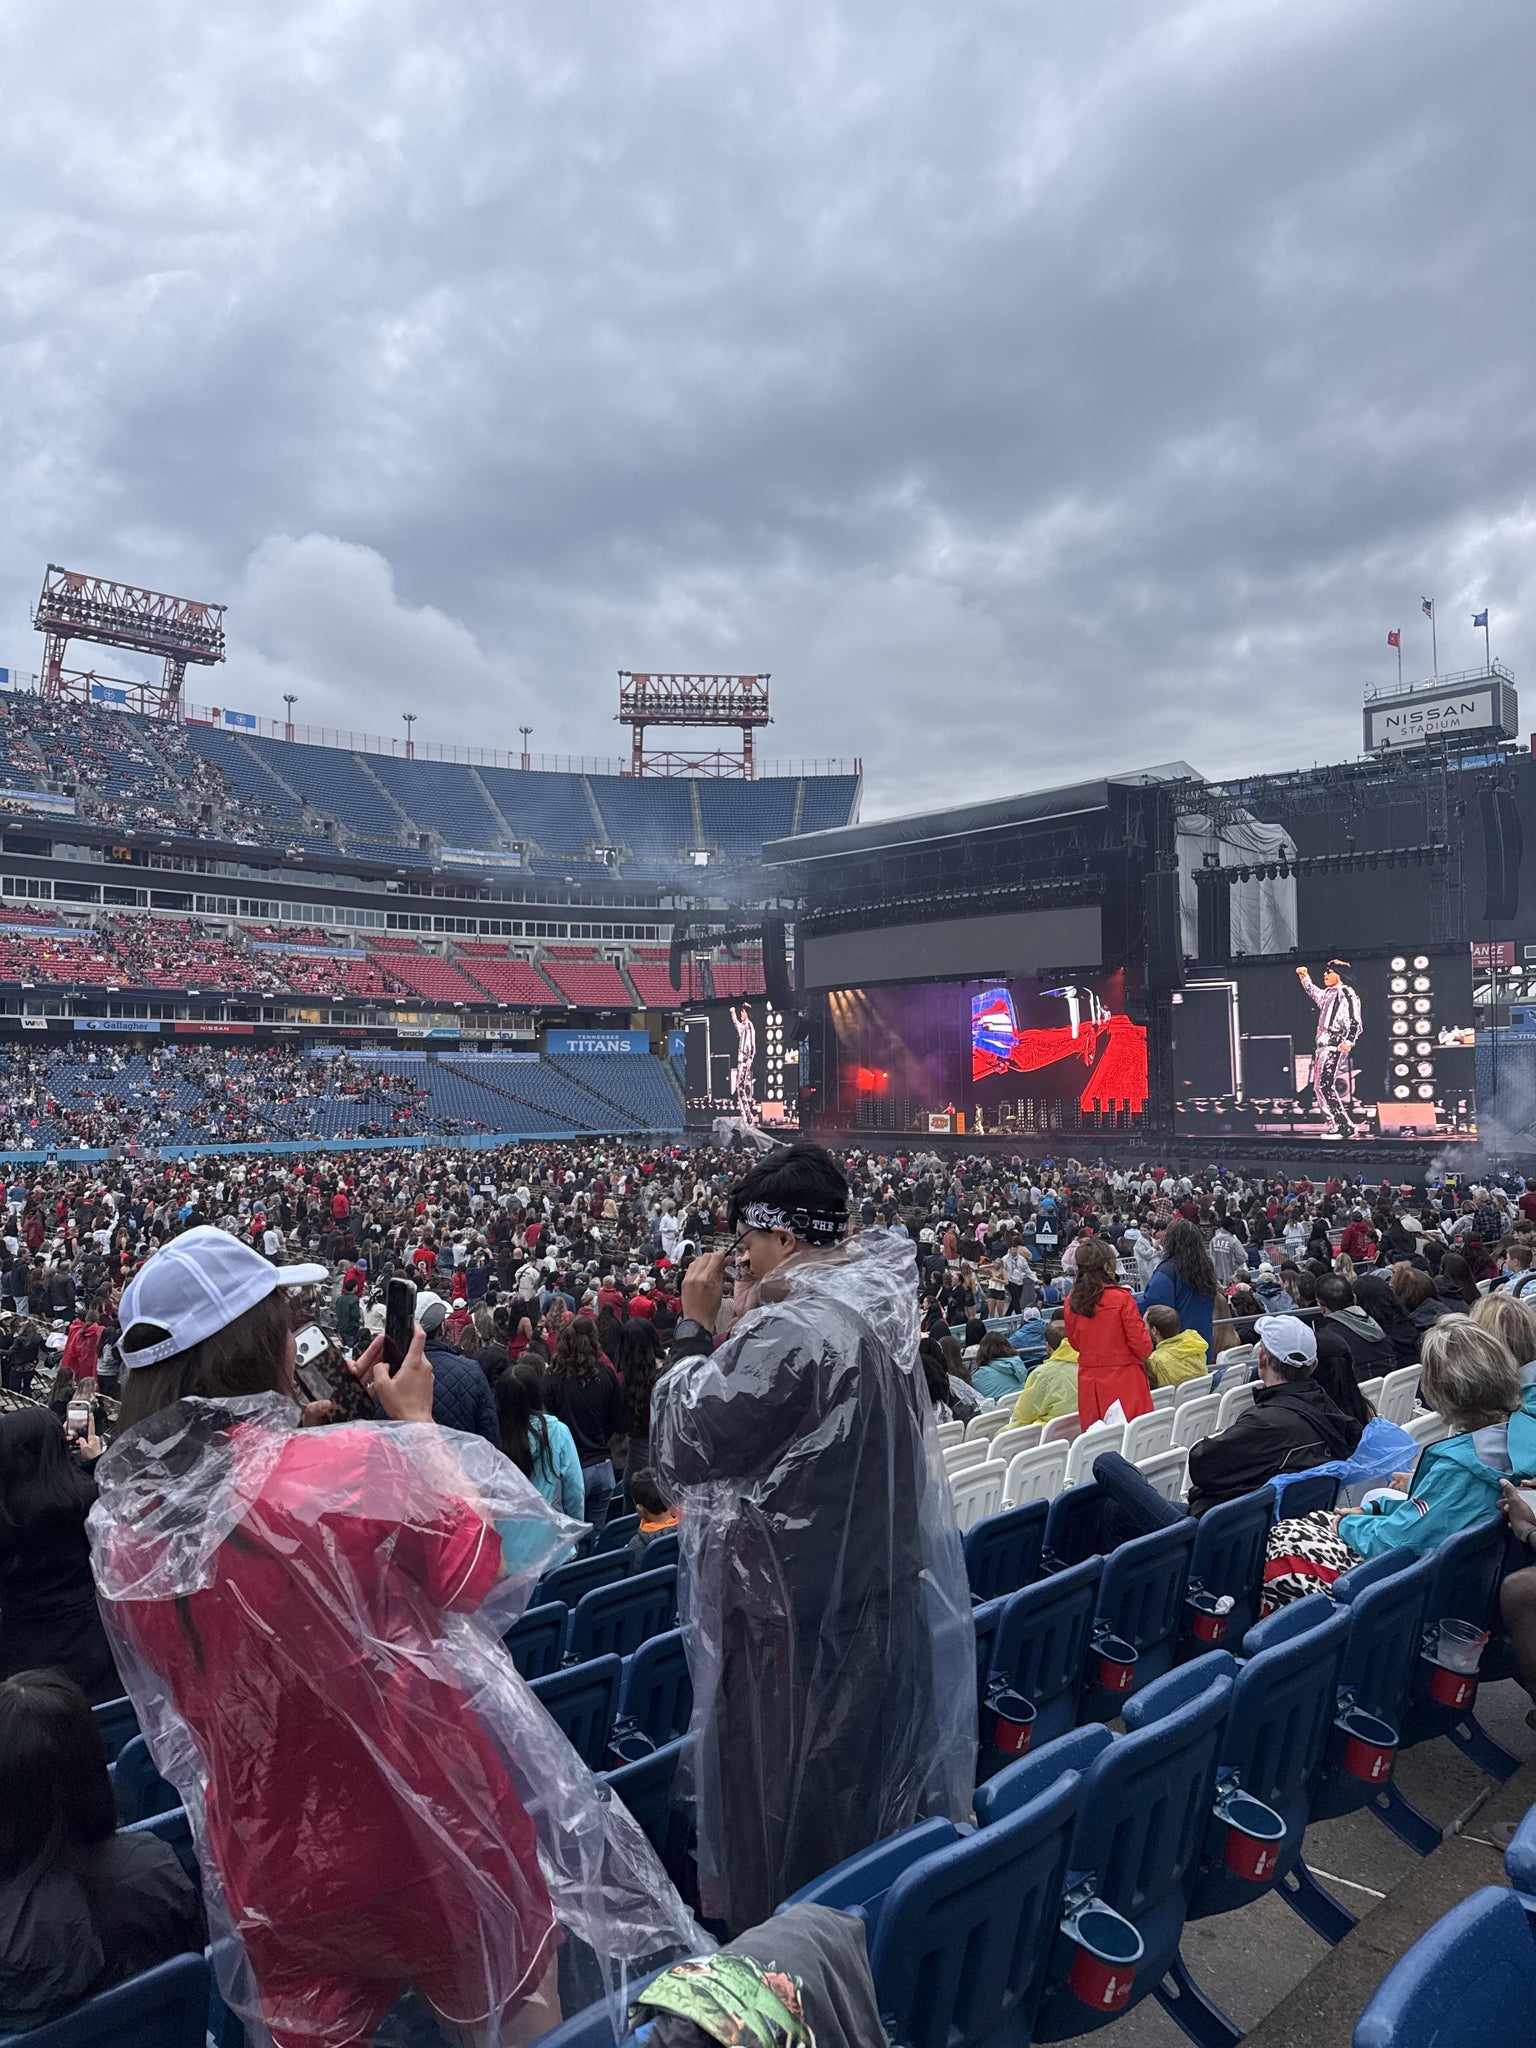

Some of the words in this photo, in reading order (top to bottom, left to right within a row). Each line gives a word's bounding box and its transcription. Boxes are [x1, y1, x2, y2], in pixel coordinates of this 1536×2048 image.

[1386, 701, 1476, 728] NISSAN
[1400, 718, 1460, 736] STADIUM
[7, 925, 33, 933] TITANS
[103, 1020, 149, 1031] Gallagher
[338, 1029, 367, 1037] verizon
[566, 1040, 631, 1052] TITANS
[812, 1219, 835, 1232] THE
[1041, 1220, 1053, 1233] A
